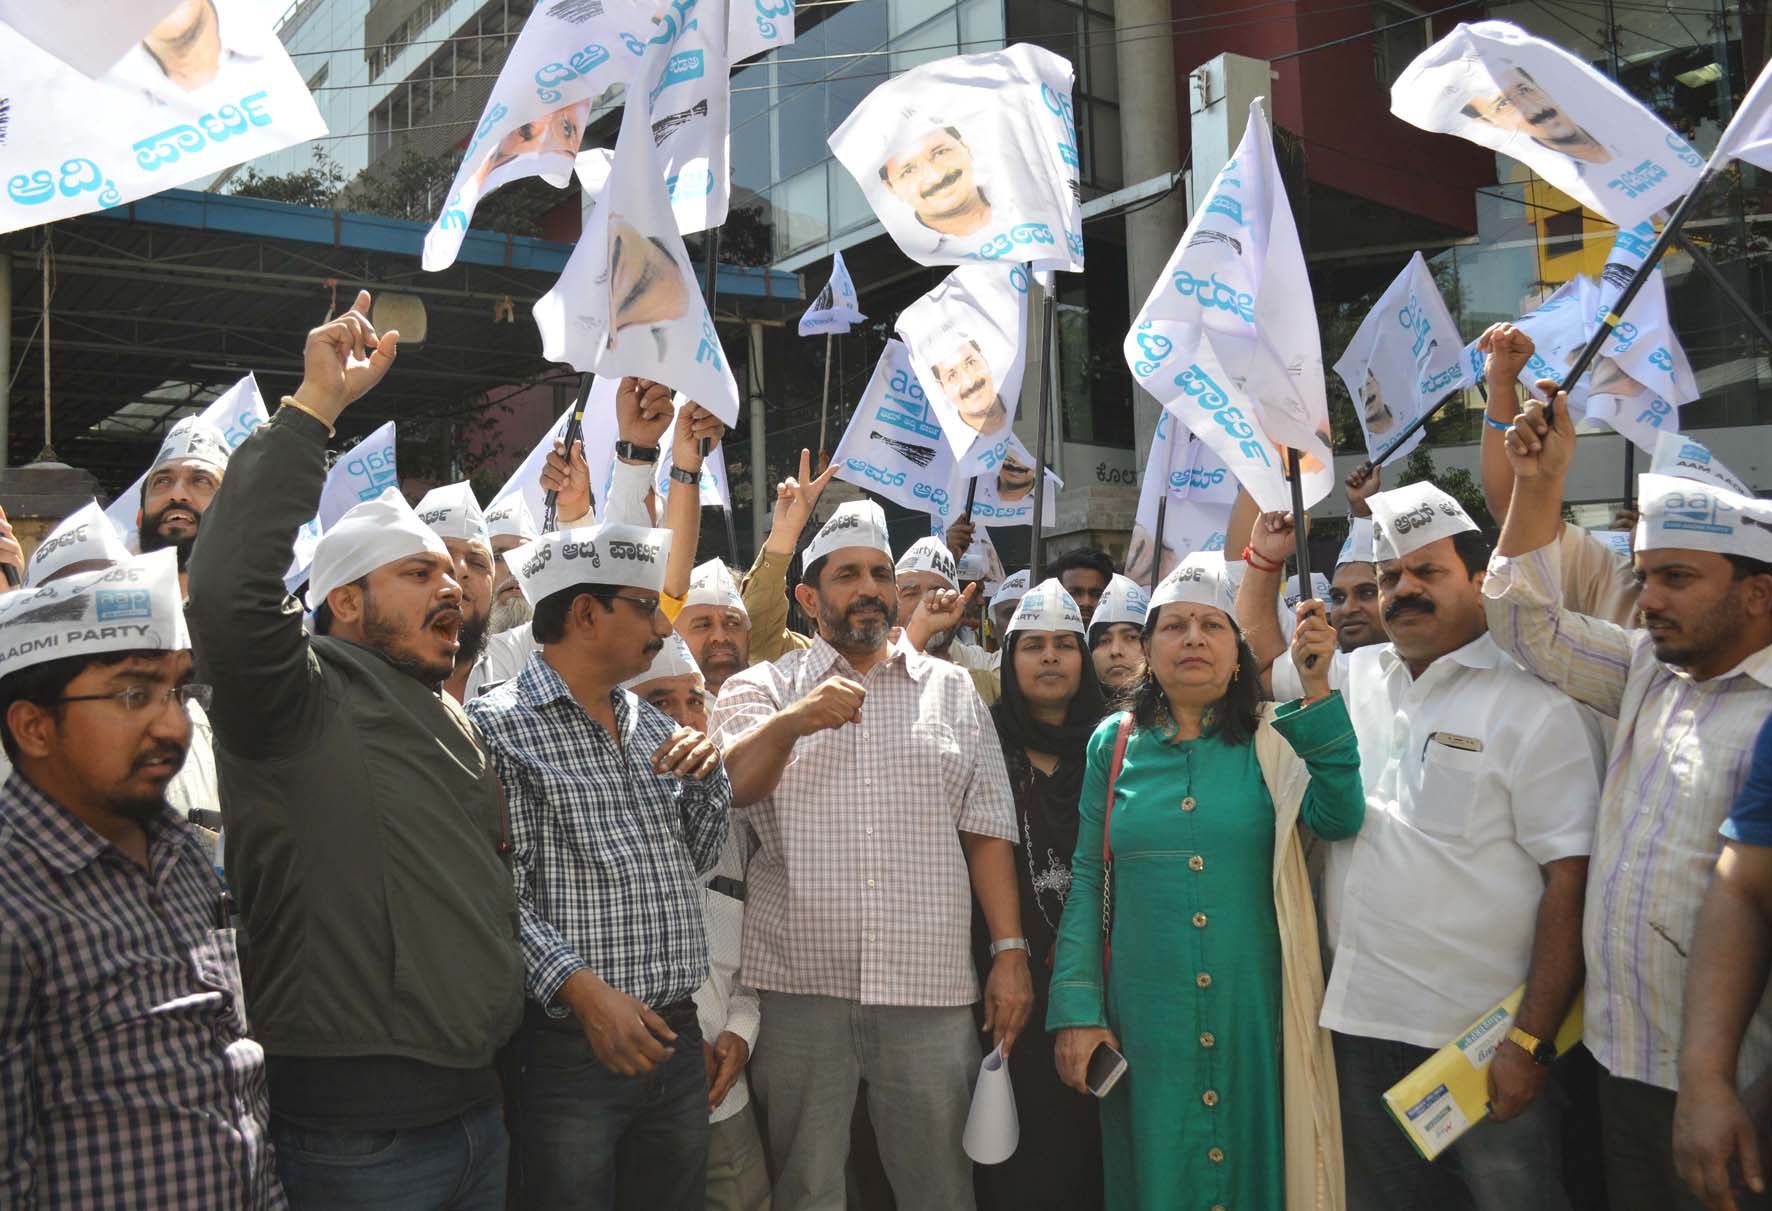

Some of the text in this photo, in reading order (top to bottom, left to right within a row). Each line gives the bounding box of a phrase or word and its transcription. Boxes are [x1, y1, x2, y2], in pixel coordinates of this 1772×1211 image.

[6, 90, 274, 209] ಆದ್ಮಿ ಪಾರ್ಟಿ
[1173, 363, 1272, 469] ಪಾರ್ಟಿ
[846, 457, 950, 516] ಆಮ್ ಆದ್ಮಿ
[1169, 465, 1227, 489] ಆಮ್
[1394, 501, 1436, 535] ಆಮ್
[67, 624, 151, 645] PARTY
